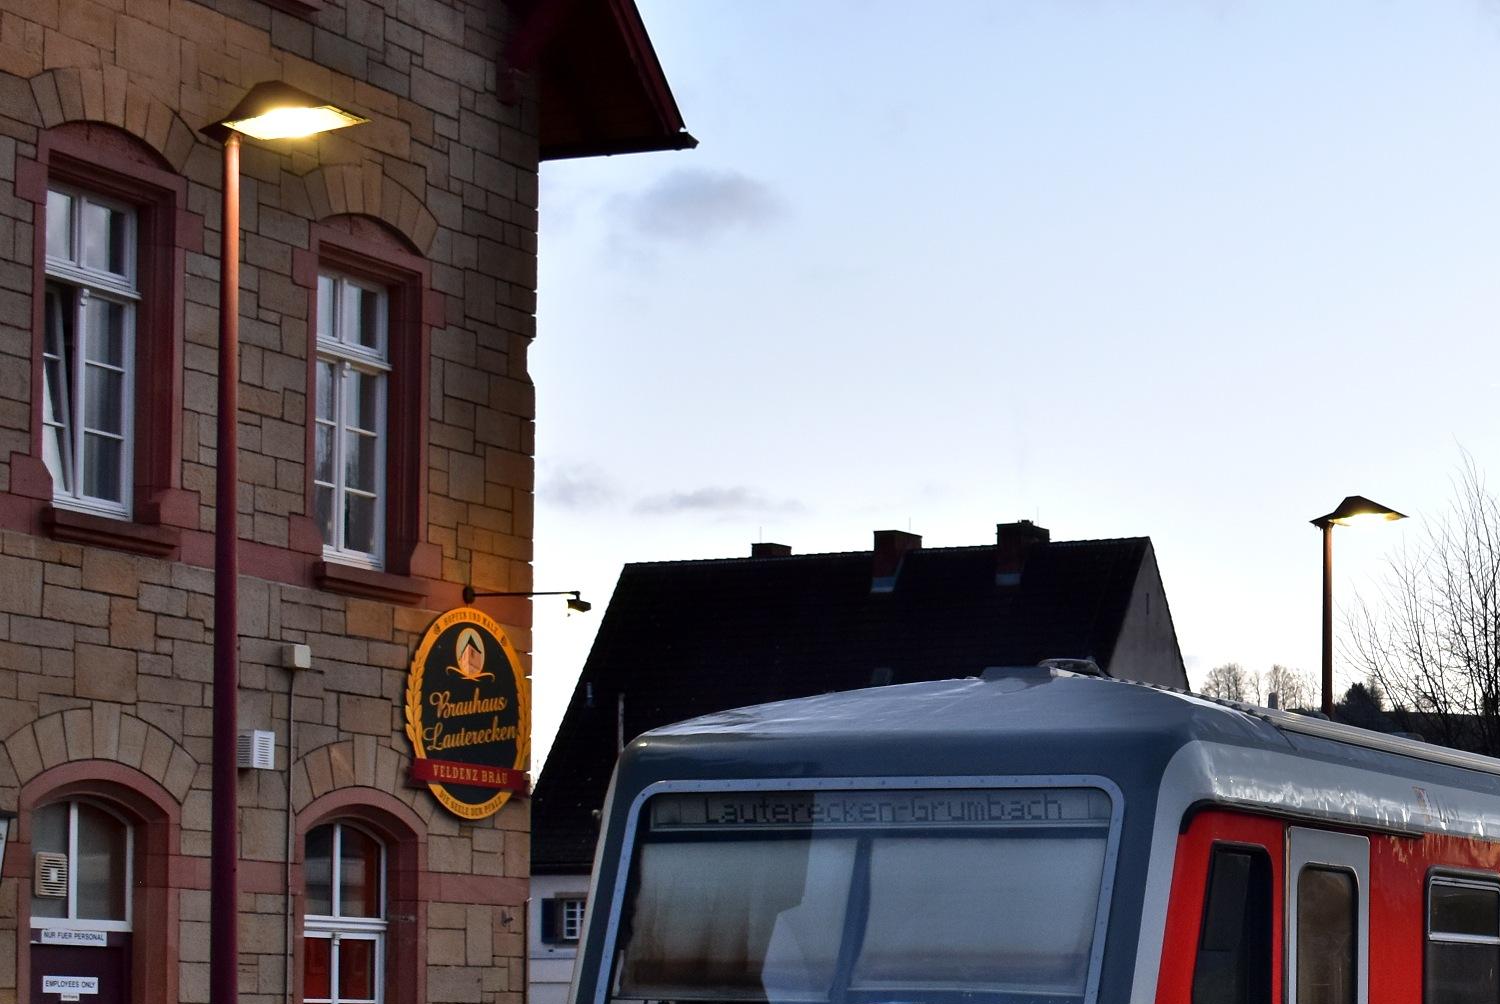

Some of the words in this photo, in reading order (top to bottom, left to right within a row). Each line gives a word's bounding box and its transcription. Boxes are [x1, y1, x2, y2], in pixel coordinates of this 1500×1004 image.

[429, 687, 508, 719] Brauhaus
[423, 715, 516, 751] Lauterecken
[433, 764, 479, 781] VELDENZ
[704, 796, 1063, 824] Lauterecken-Grumbach
[43, 931, 56, 939] NUR
[58, 931, 72, 940] FUER
[74, 932, 104, 941] PERSONAL
[45, 980, 80, 988] EMPLOYEES
[81, 981, 96, 989] ONLY
